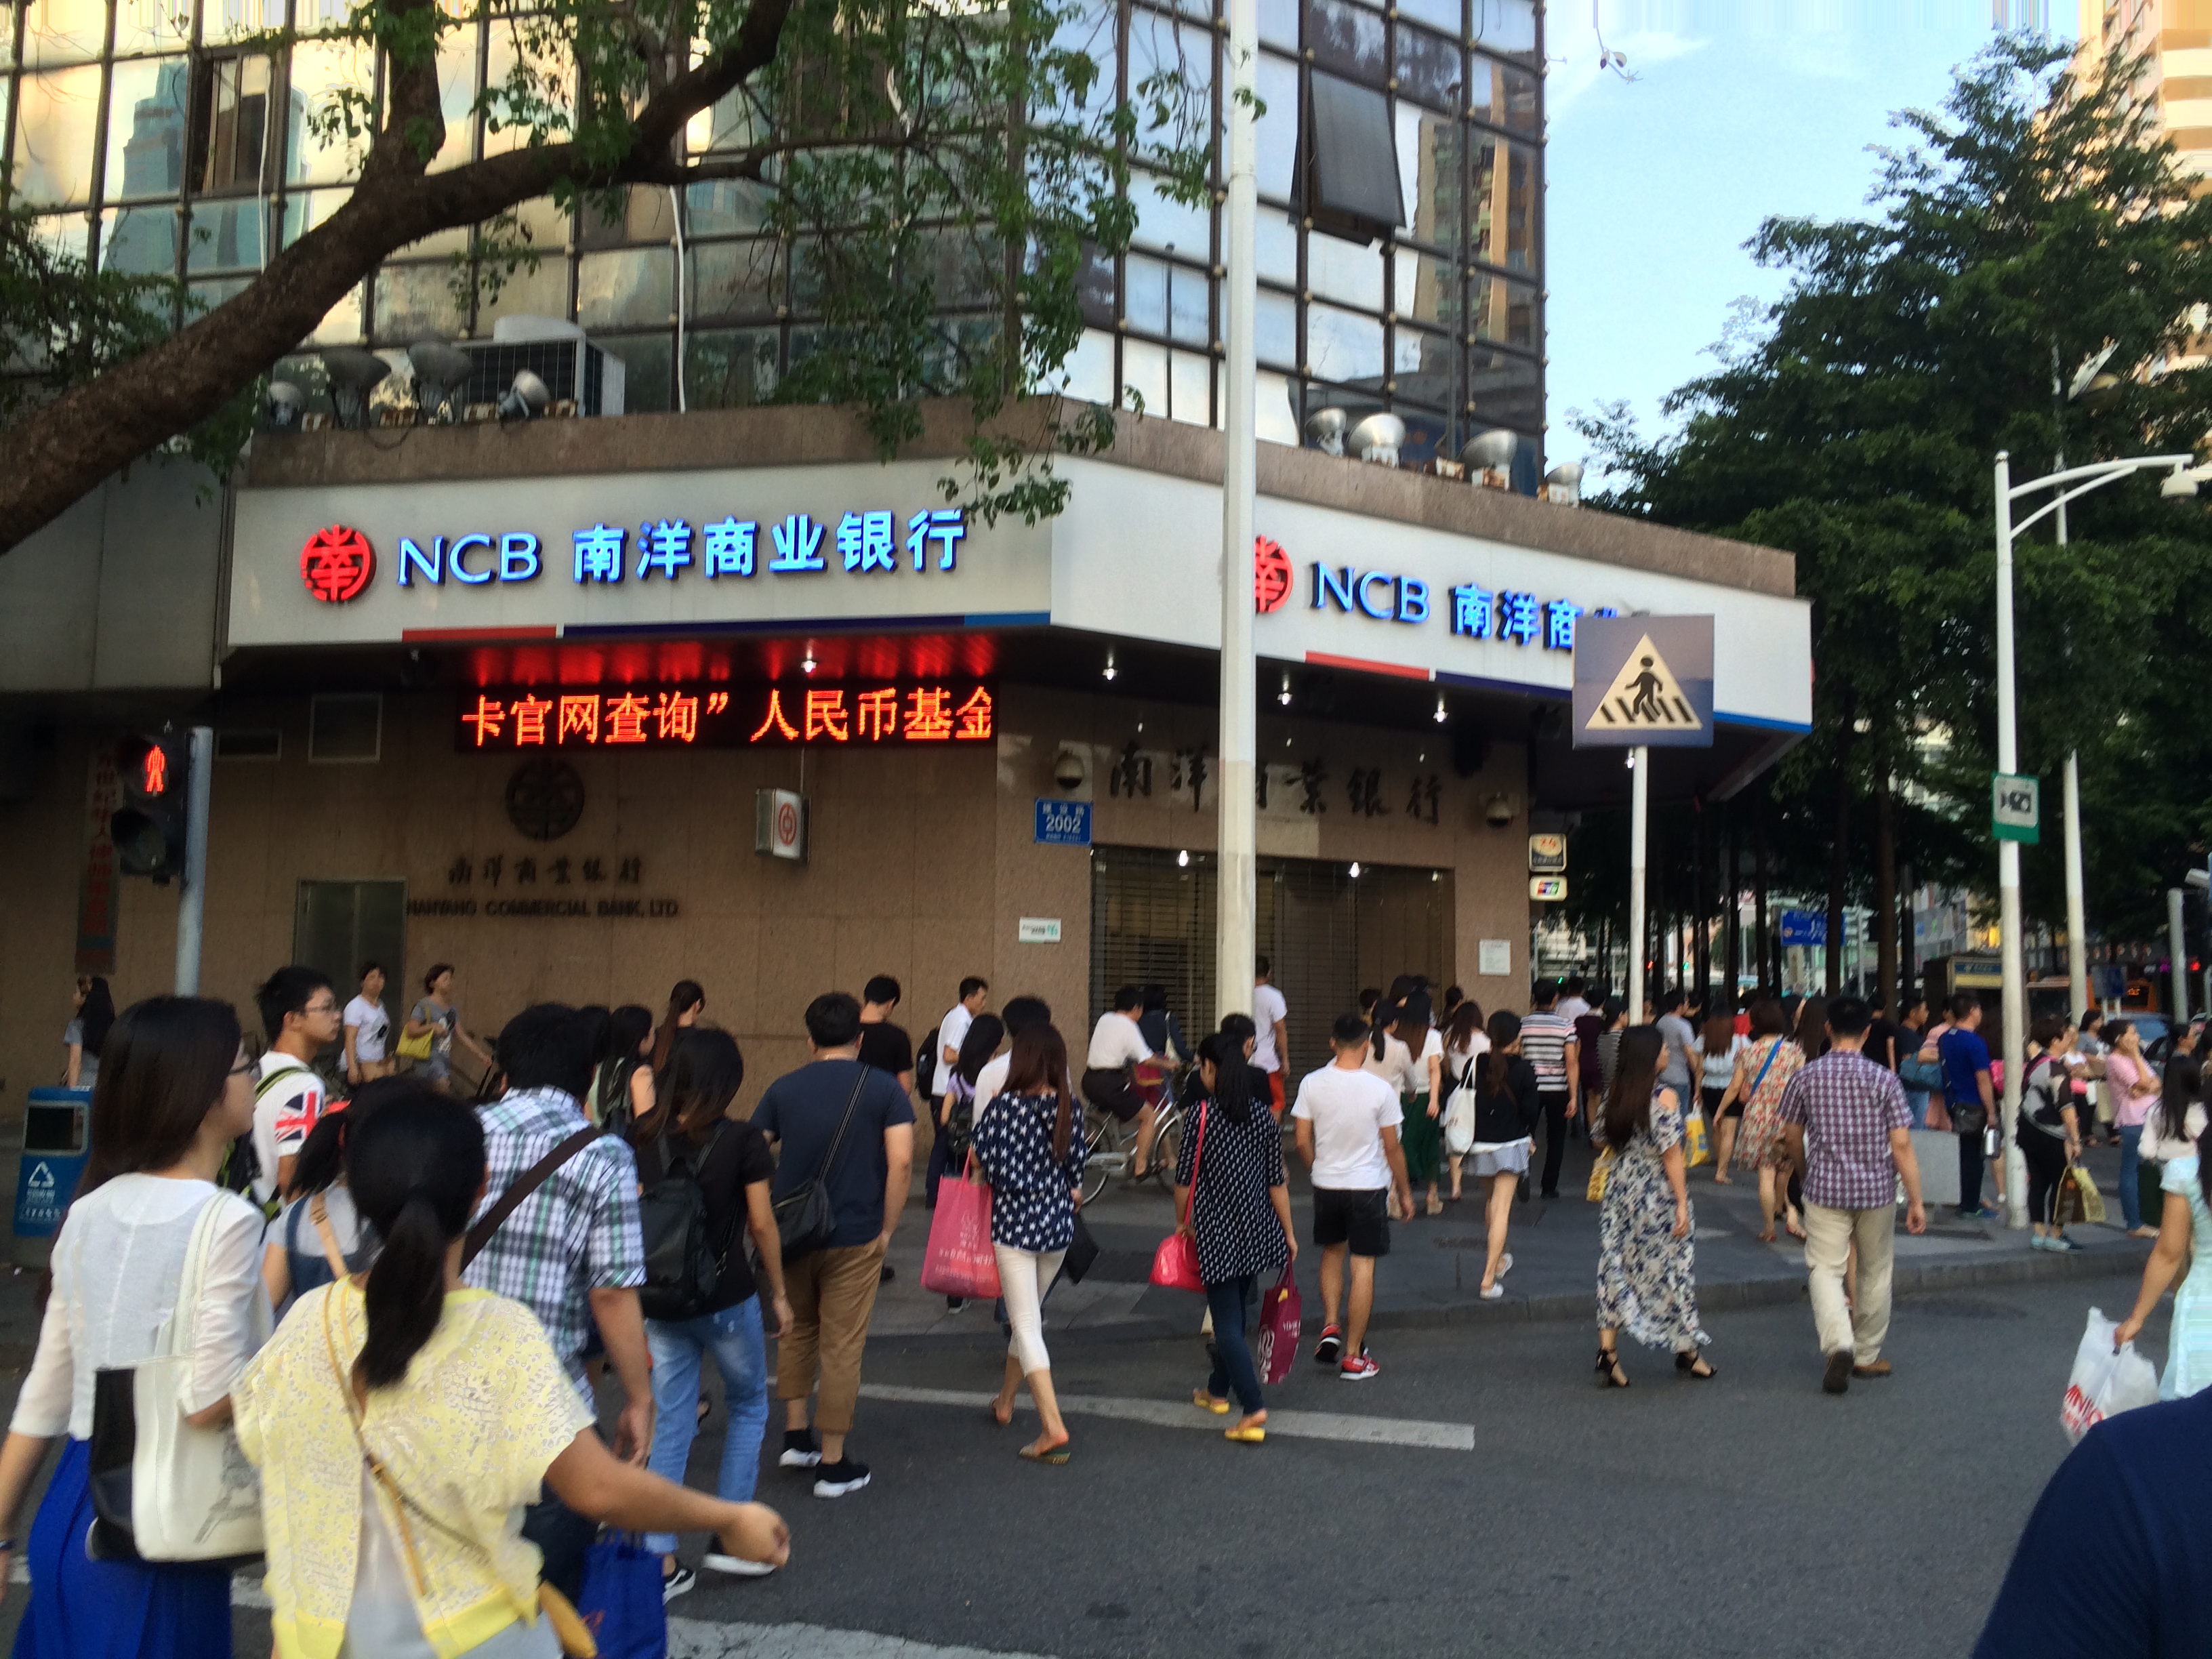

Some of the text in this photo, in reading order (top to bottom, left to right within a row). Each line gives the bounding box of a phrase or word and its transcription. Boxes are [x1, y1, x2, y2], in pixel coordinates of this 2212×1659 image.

[397, 532, 541, 586] NCB
[572, 508, 966, 583] 南洋商业银行
[1312, 560, 1431, 623] NCB
[1451, 583, 1618, 650] 南洋商
[750, 686, 991, 742] 人民币基金
[1045, 814, 1082, 834] 2002
[484, 897, 592, 918] COMMERCIAL
